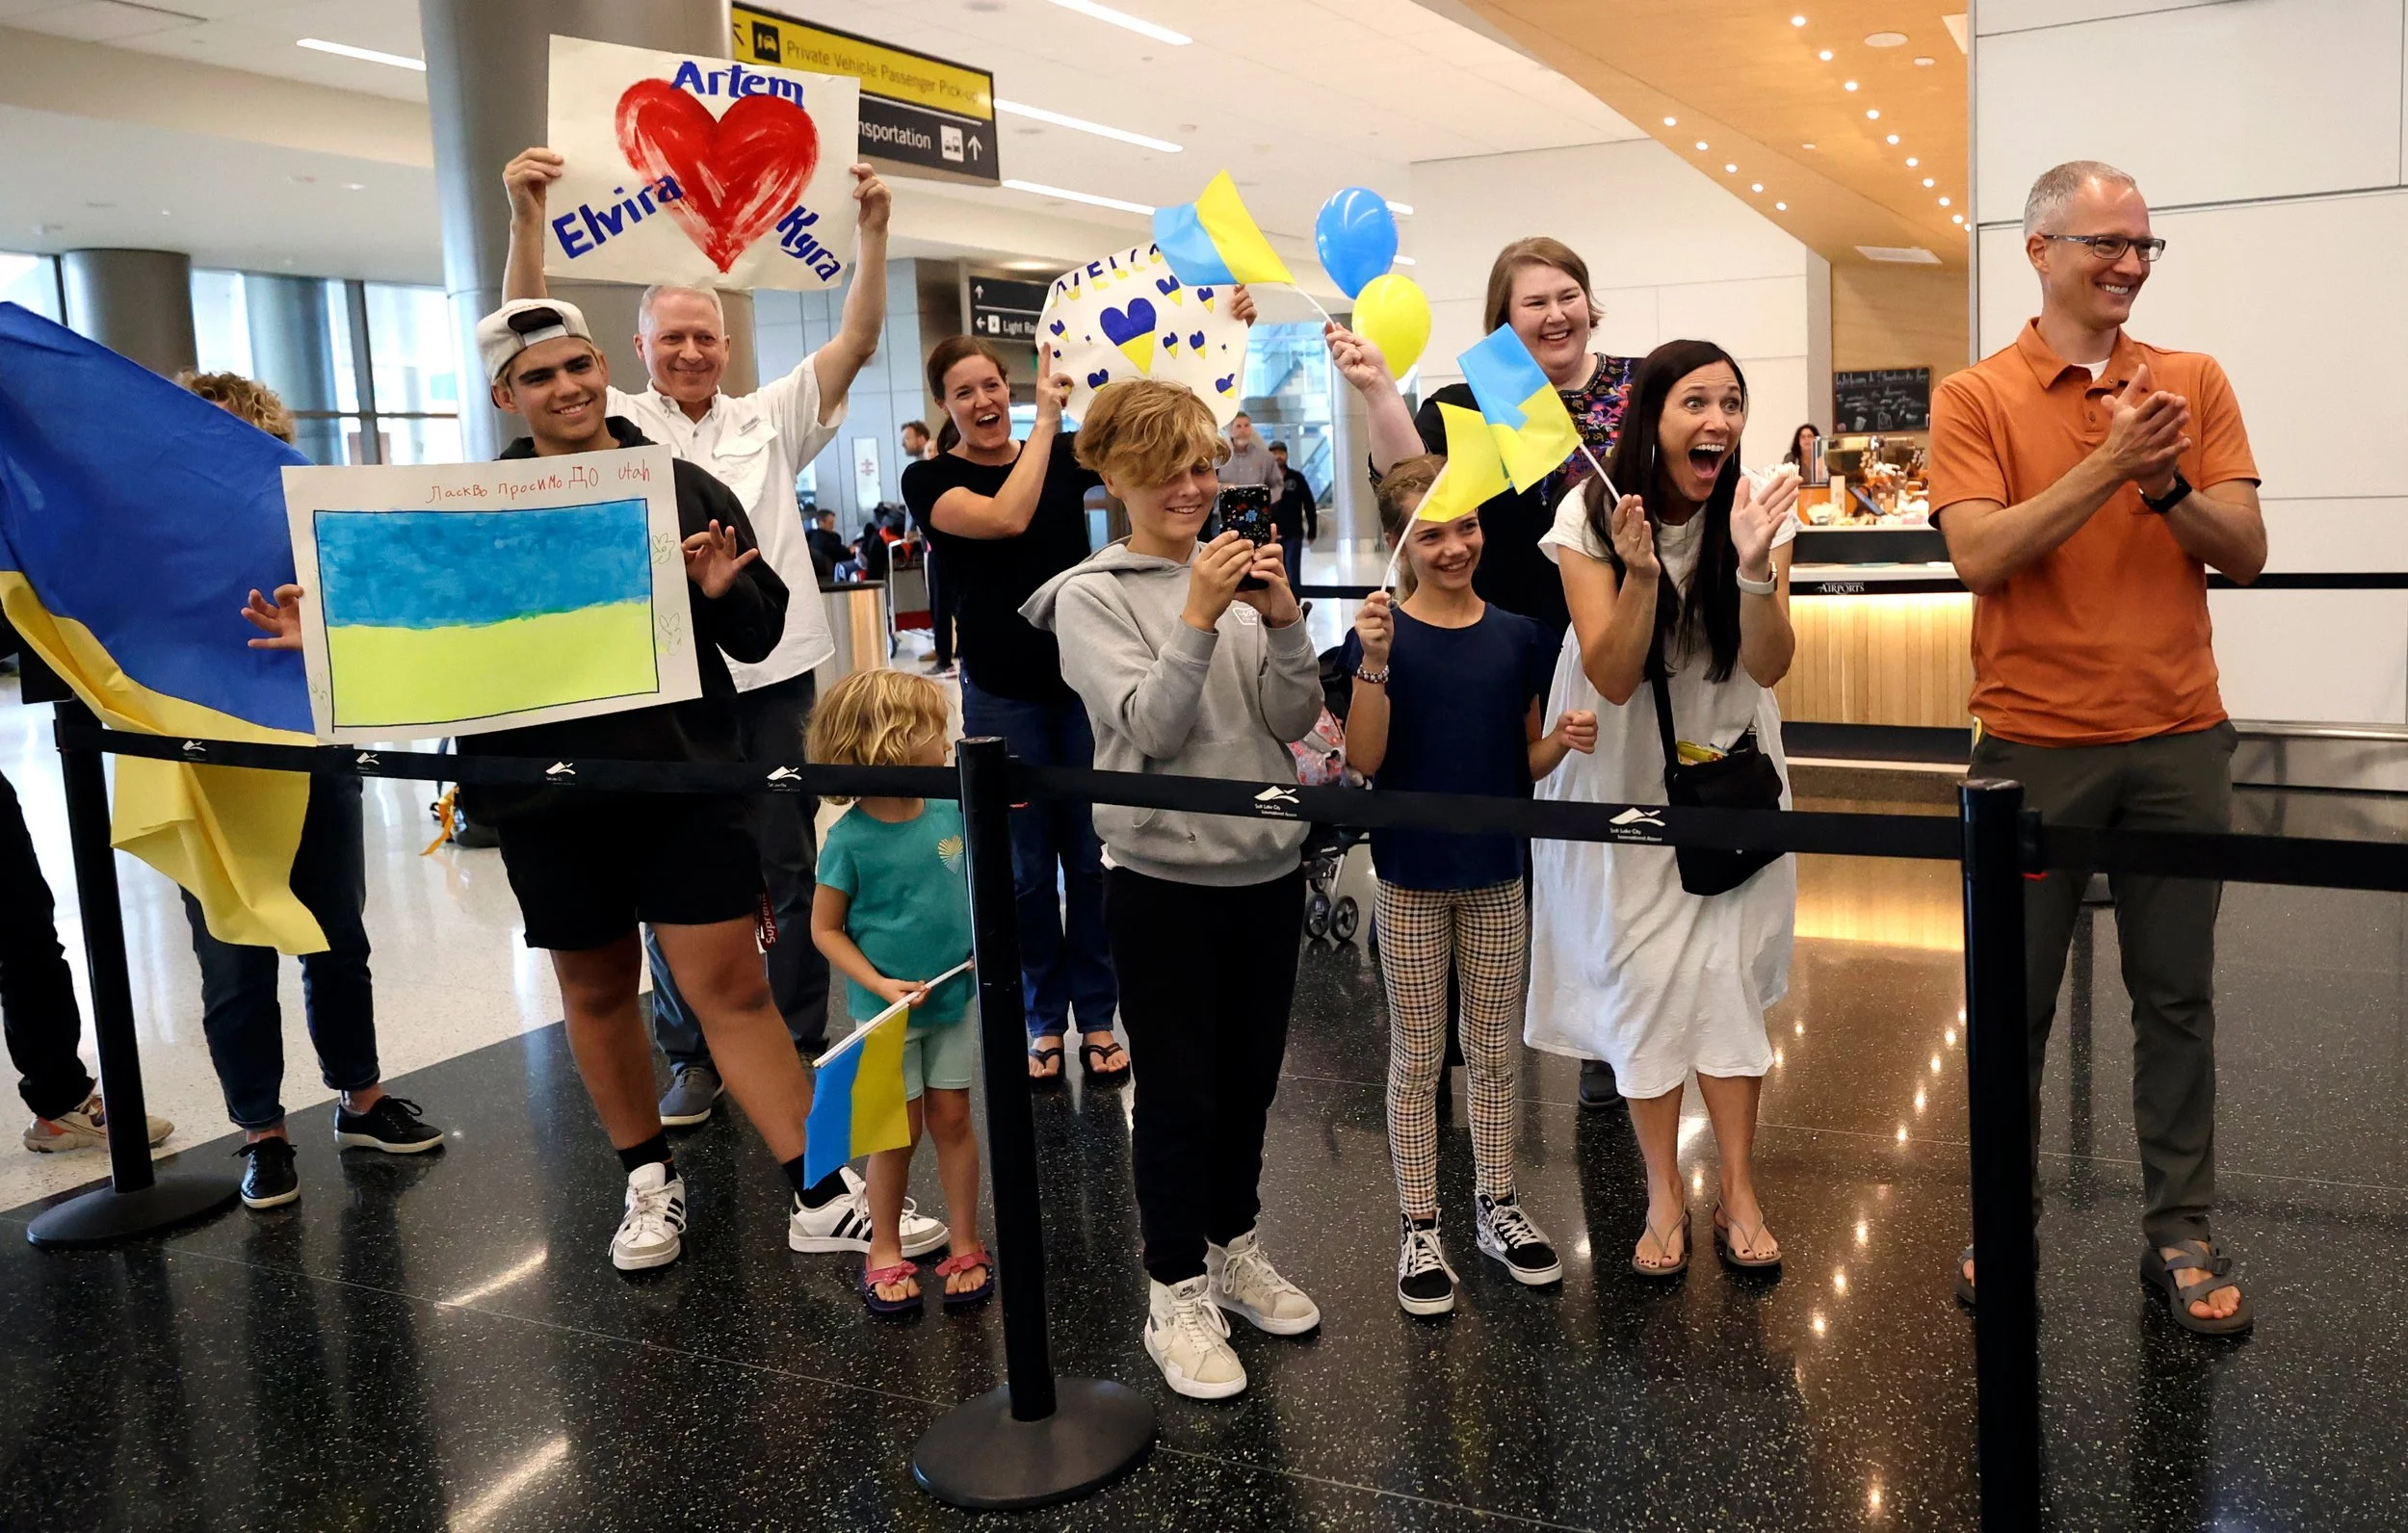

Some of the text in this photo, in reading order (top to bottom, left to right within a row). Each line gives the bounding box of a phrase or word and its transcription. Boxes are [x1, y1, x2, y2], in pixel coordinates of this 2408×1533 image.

[669, 60, 805, 109] Artem
[786, 39, 979, 105] Private Vehicle Passenger Pick-up
[551, 174, 685, 260] Elvira
[775, 205, 842, 282] Kyra
[1003, 320, 1023, 336] Light
